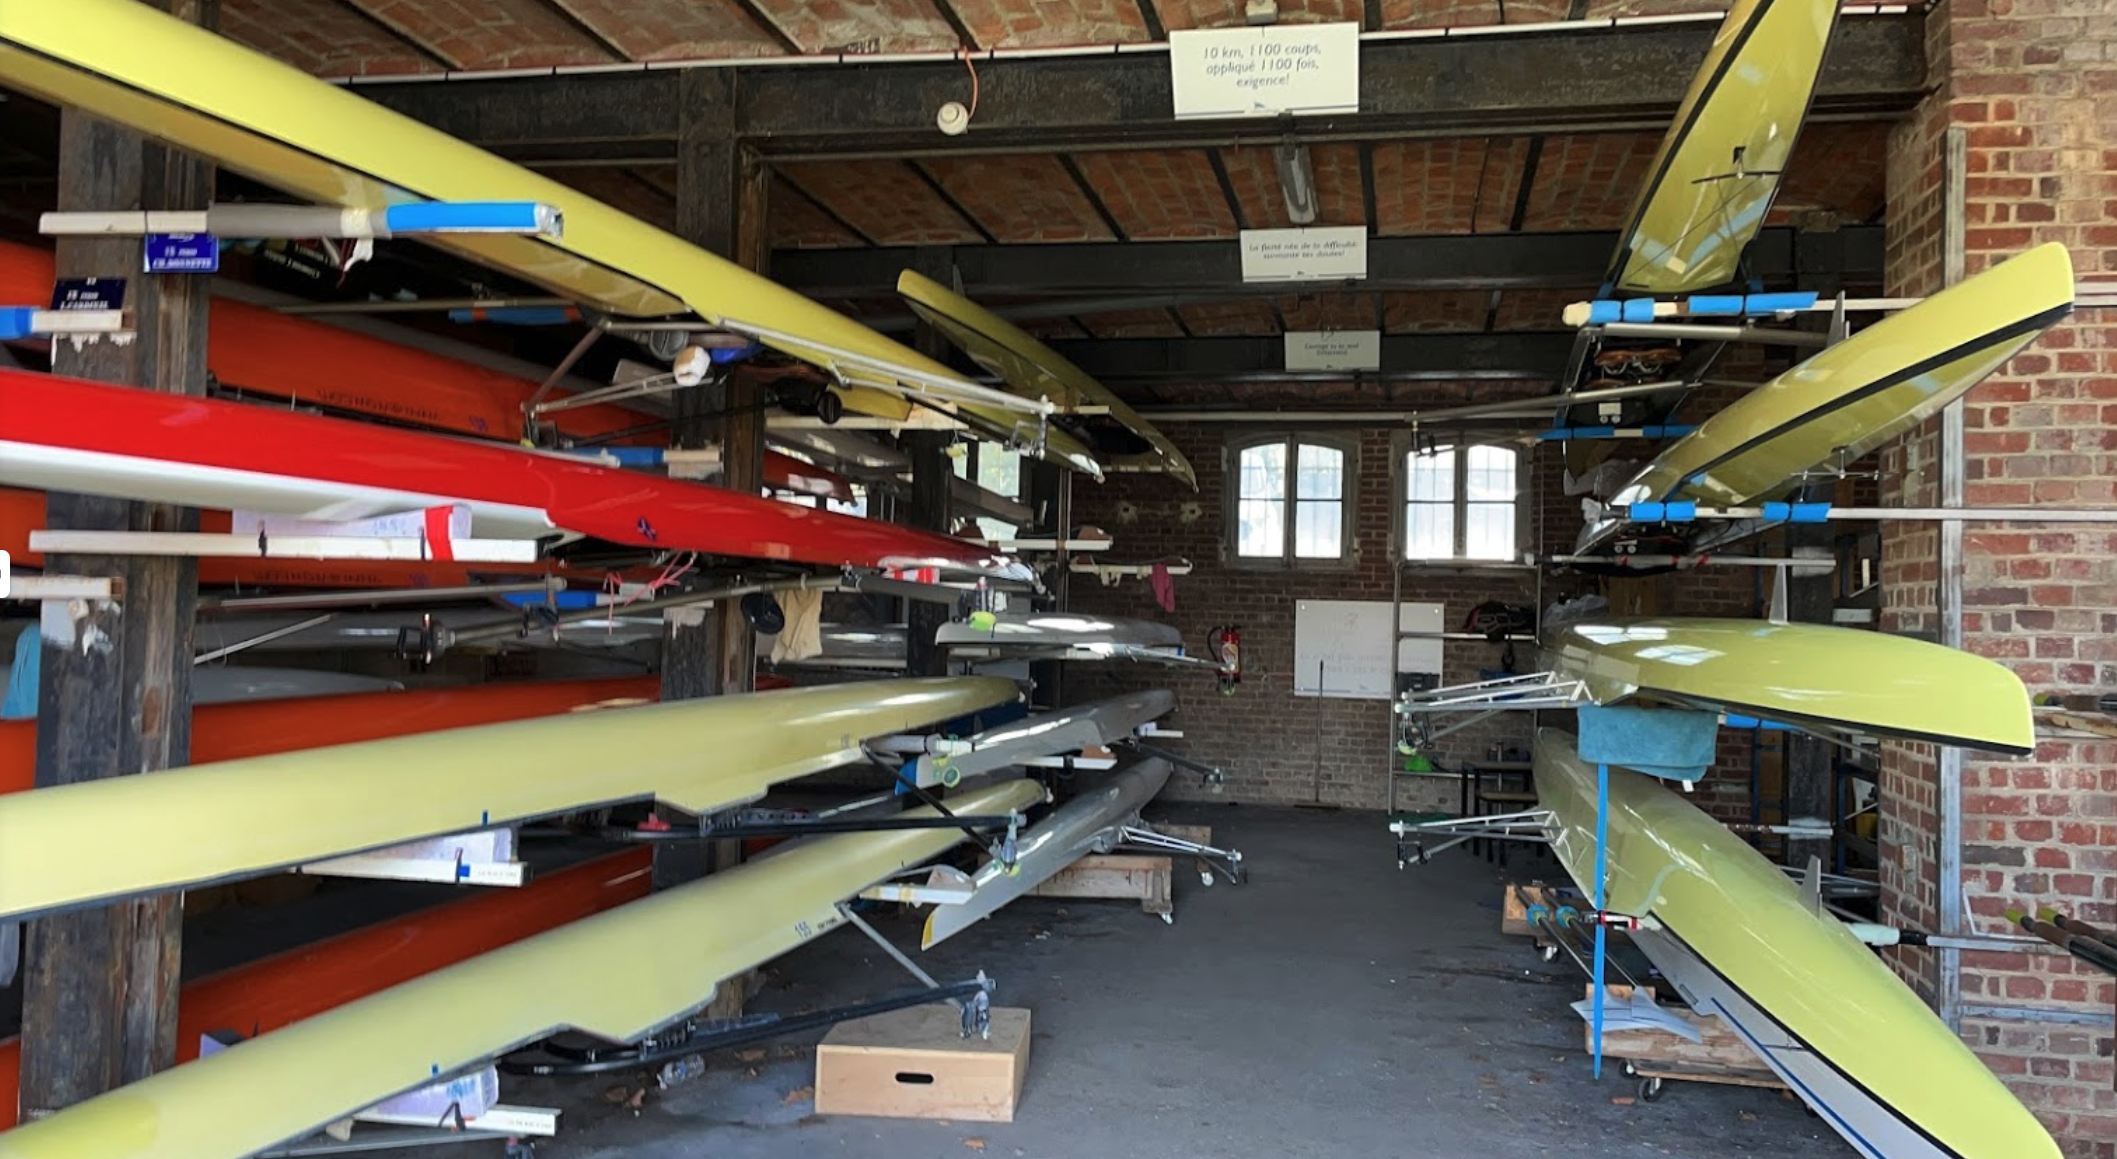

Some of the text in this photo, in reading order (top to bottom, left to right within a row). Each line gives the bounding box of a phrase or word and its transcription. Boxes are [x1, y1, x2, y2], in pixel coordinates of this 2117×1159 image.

[1204, 43, 1321, 60] 10 km, 1100 coups,
[1206, 56, 1319, 76] appliqué 1100 fois,
[1236, 73, 1290, 90] exigence!
